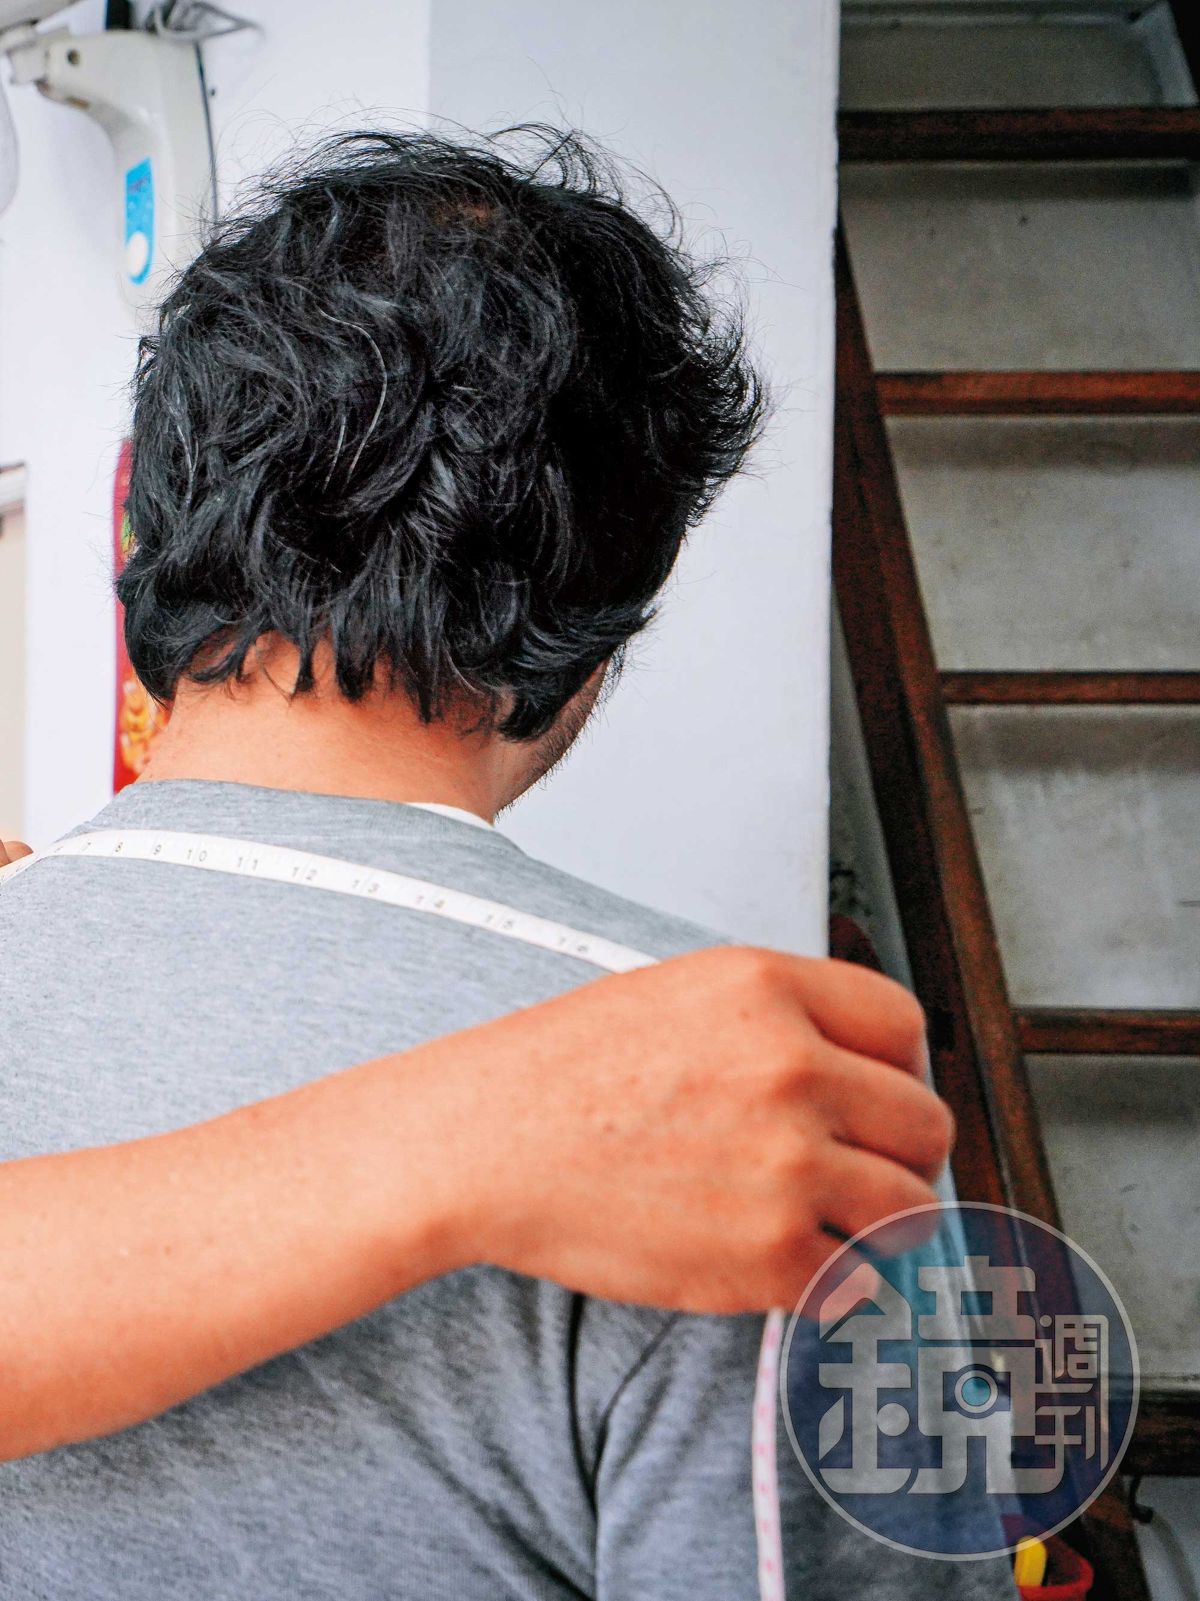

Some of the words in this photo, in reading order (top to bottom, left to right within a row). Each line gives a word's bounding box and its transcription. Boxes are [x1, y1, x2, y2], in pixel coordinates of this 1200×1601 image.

[186, 848, 208, 862] 10
[236, 856, 259, 872] 11
[291, 866, 318, 881] 12
